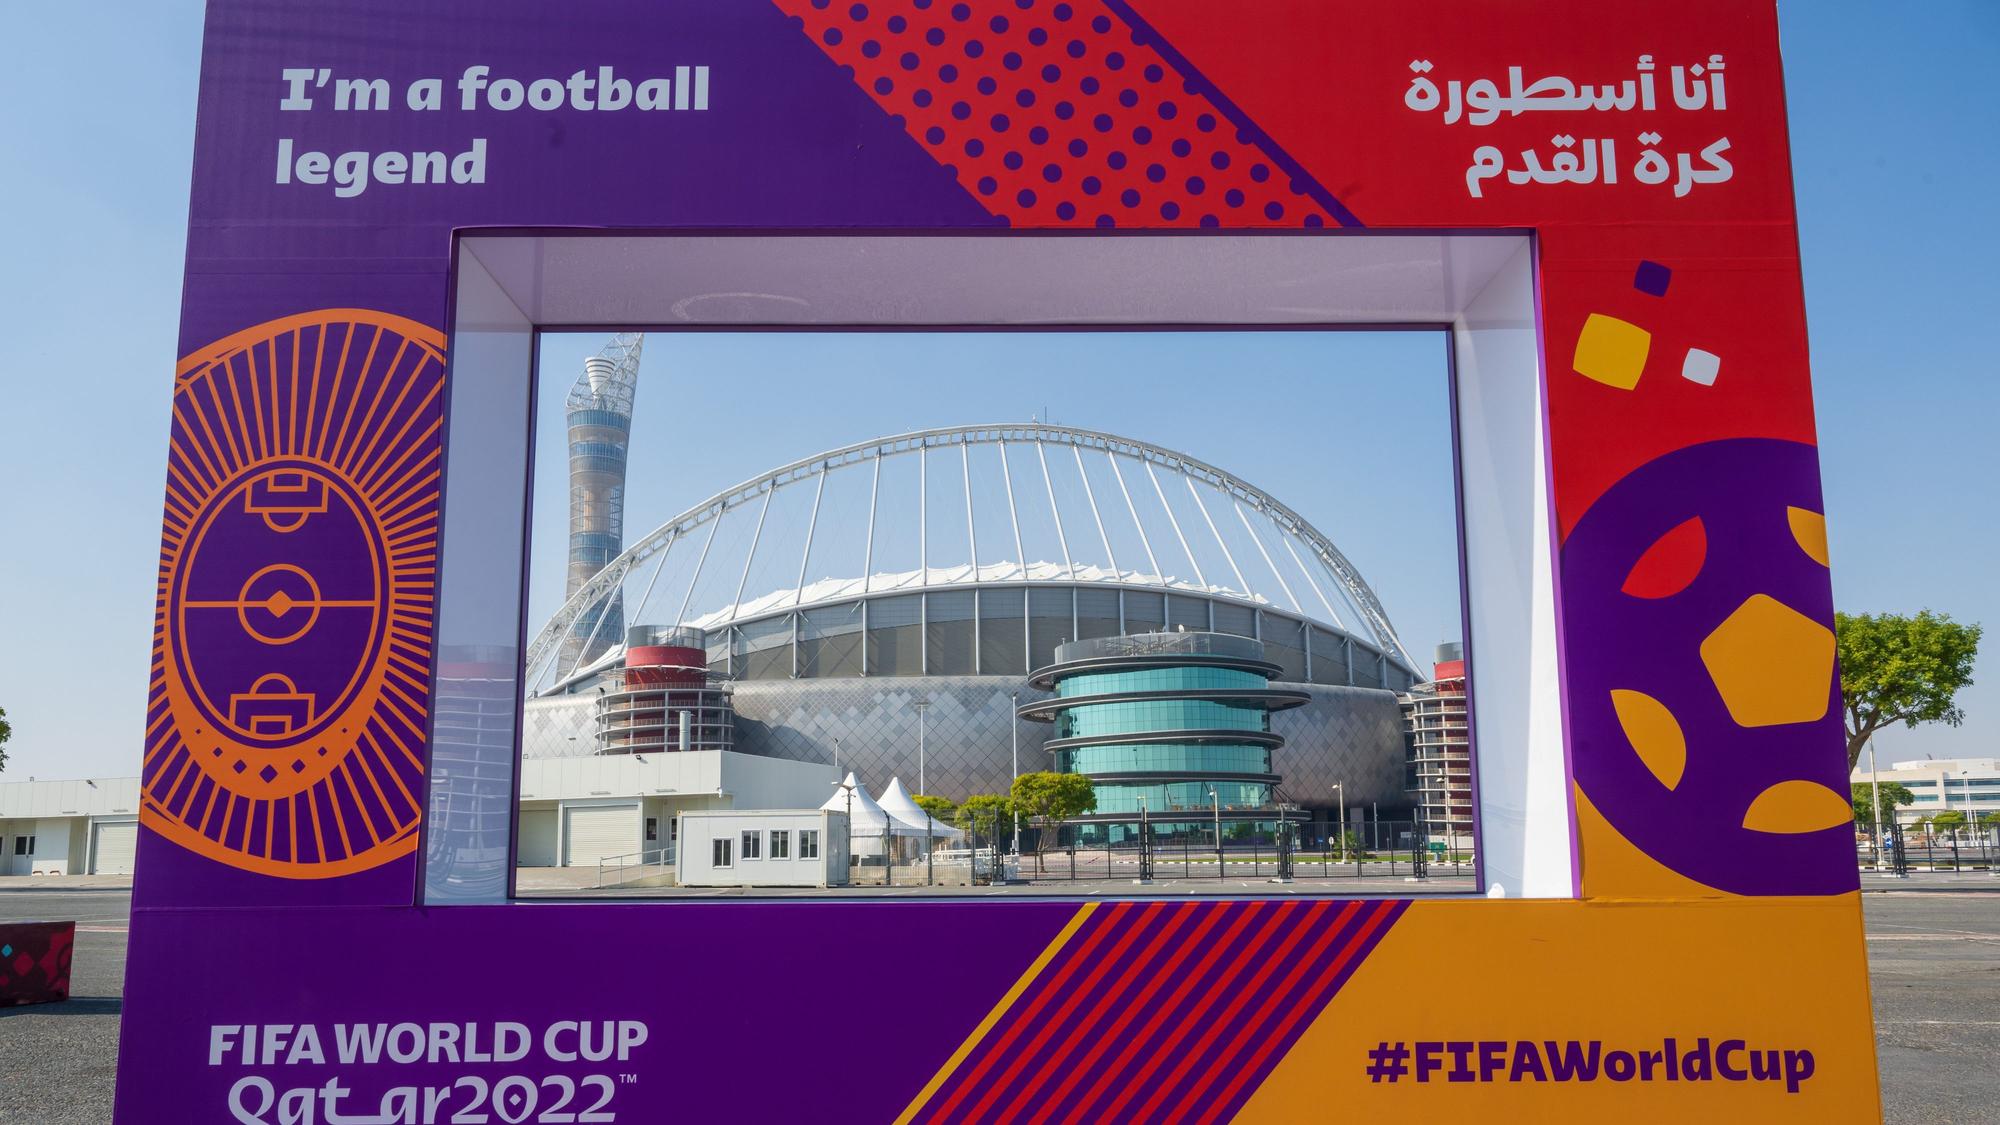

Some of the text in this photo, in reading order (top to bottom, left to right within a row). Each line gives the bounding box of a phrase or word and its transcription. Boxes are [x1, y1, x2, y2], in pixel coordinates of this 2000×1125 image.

[280, 65, 710, 111] I’m a football
[1404, 54, 1728, 126] أنا أسطورة
[275, 138, 487, 198] legend
[1465, 131, 1734, 198] كرة القدم
[208, 1020, 648, 1065] FIFA WORLD CUP
[1365, 1037, 1816, 1094] #FIFAWorldCup
